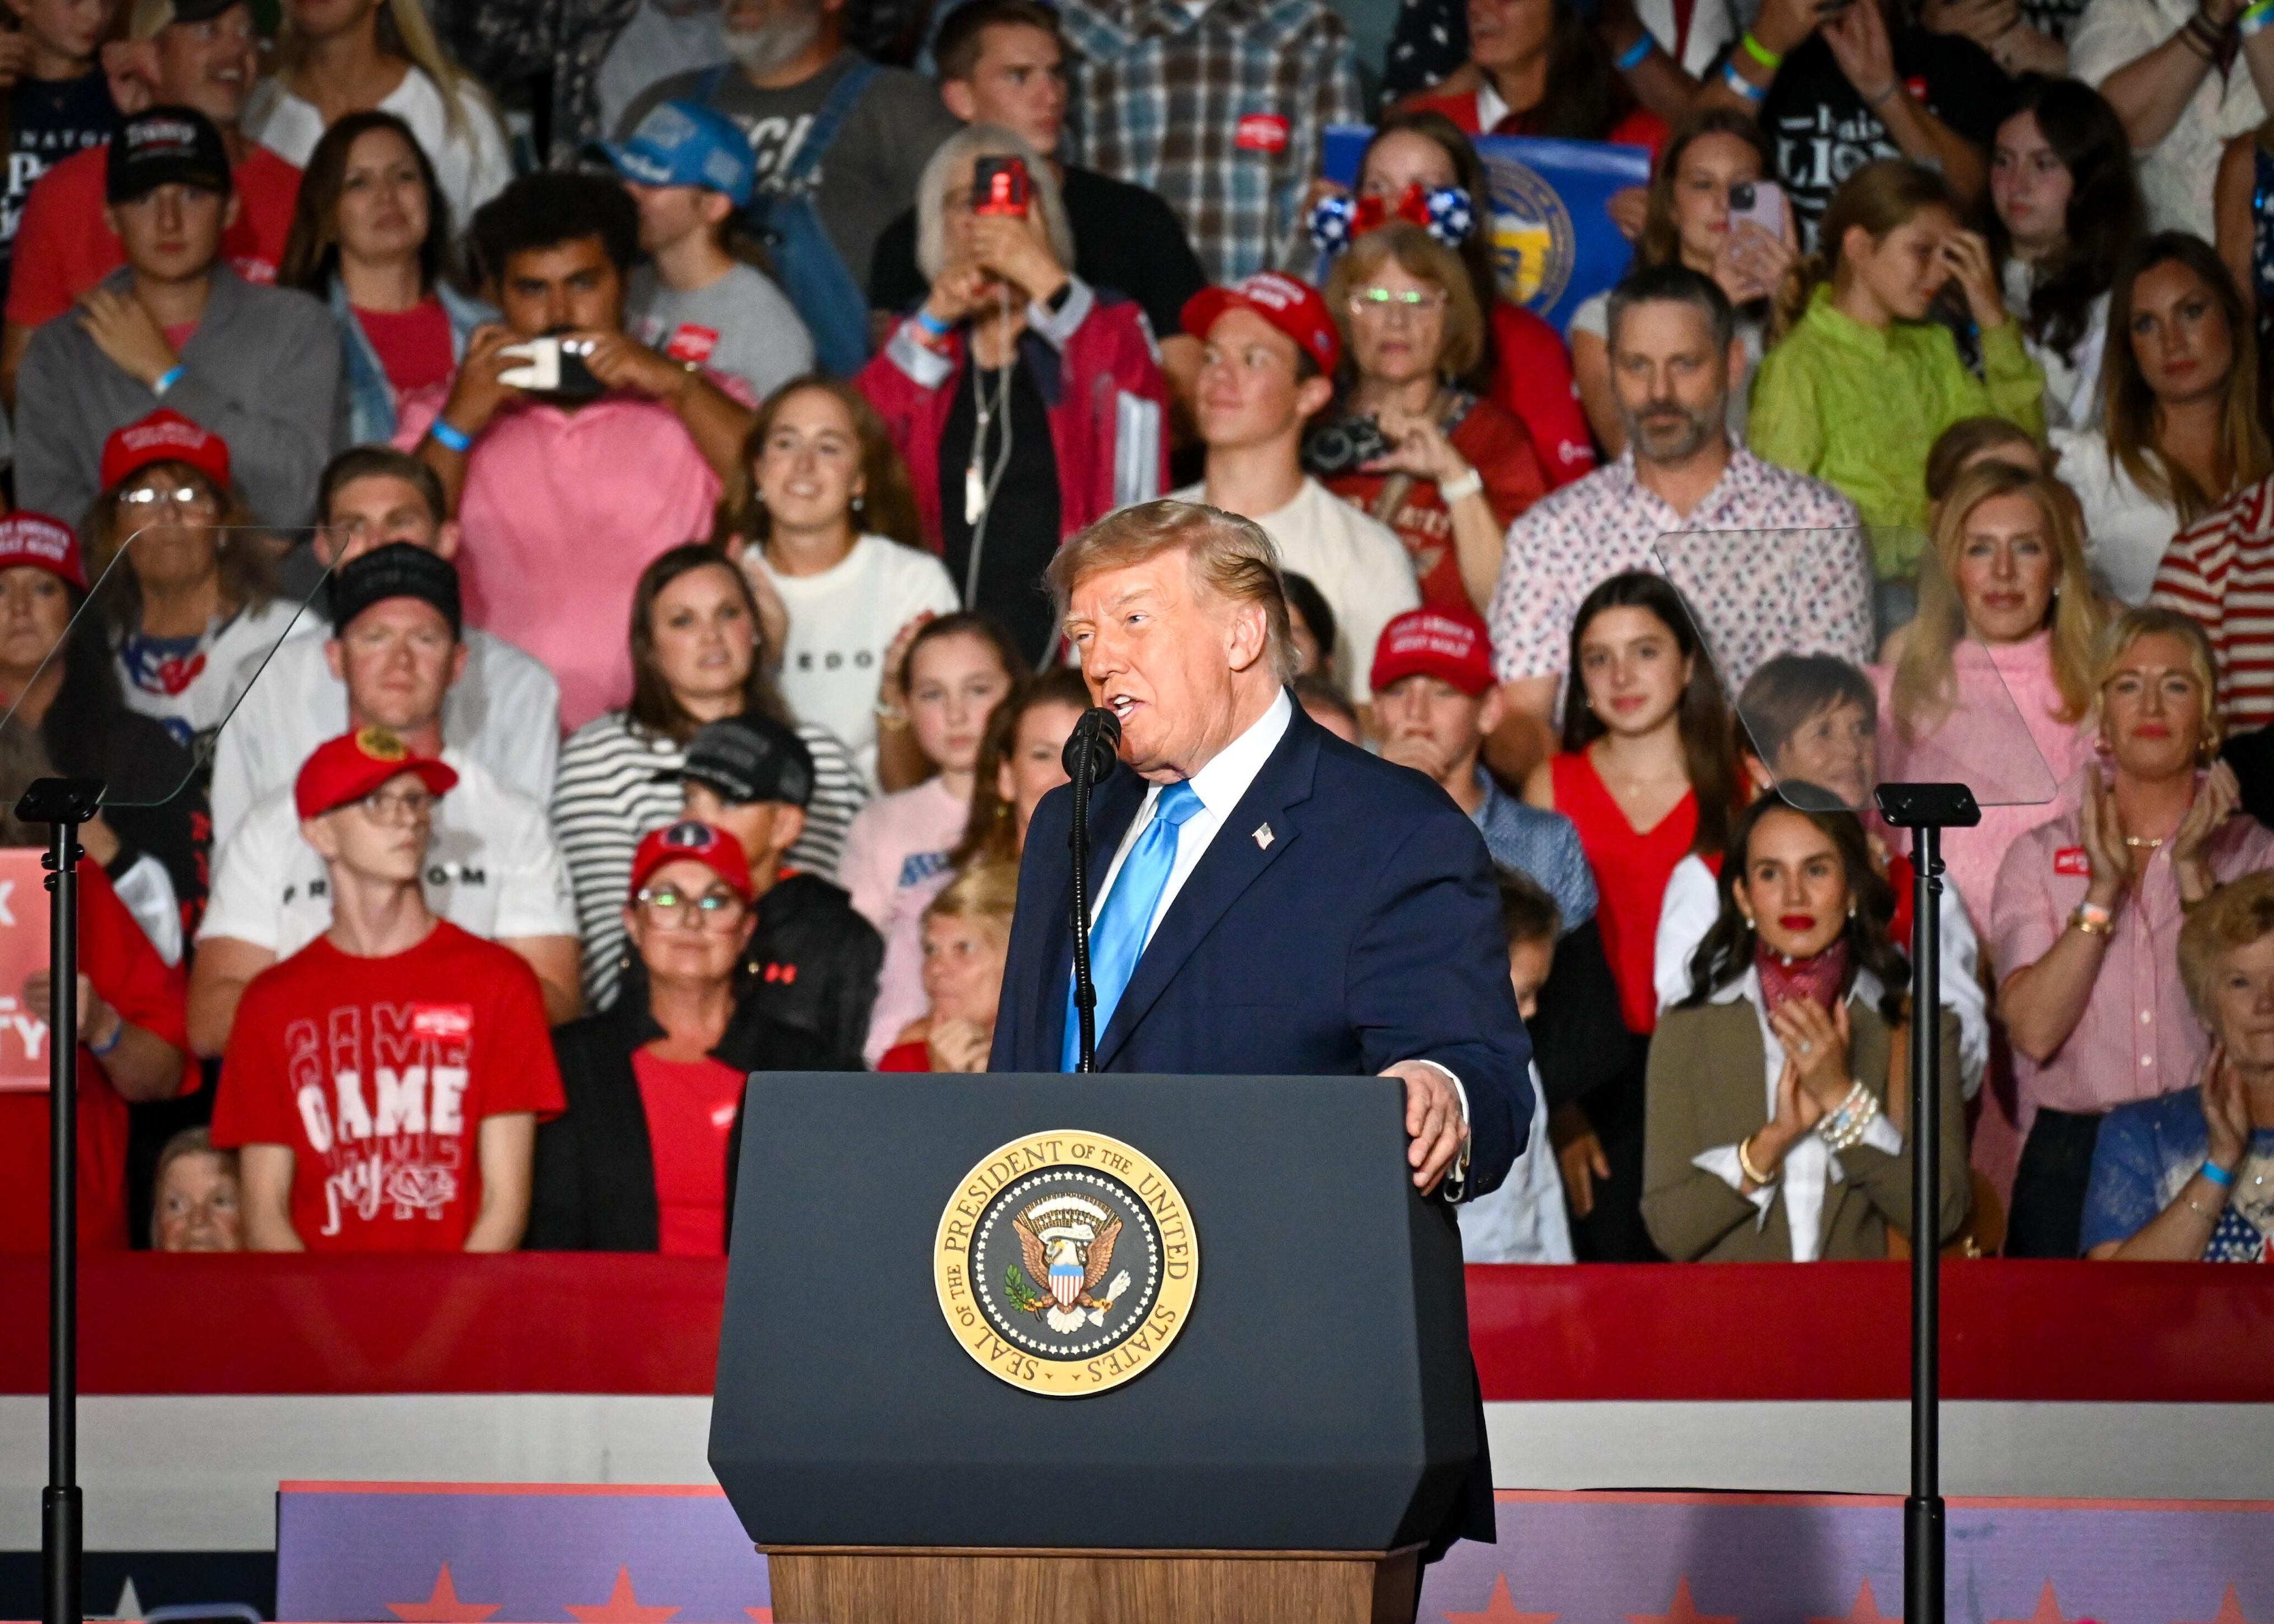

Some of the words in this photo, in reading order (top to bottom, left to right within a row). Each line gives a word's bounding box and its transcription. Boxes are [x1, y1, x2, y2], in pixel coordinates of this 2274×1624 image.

[1071, 1143, 1096, 1159] OF
[1101, 1148, 1133, 1175] THE
[944, 1140, 1063, 1254] PRESIDENT
[1138, 1172, 1189, 1280] UNITED
[947, 1264, 965, 1300] THE
[955, 1305, 975, 1326] OF
[975, 1326, 1039, 1381] SEAL
[1087, 1304, 1176, 1383] STATES
